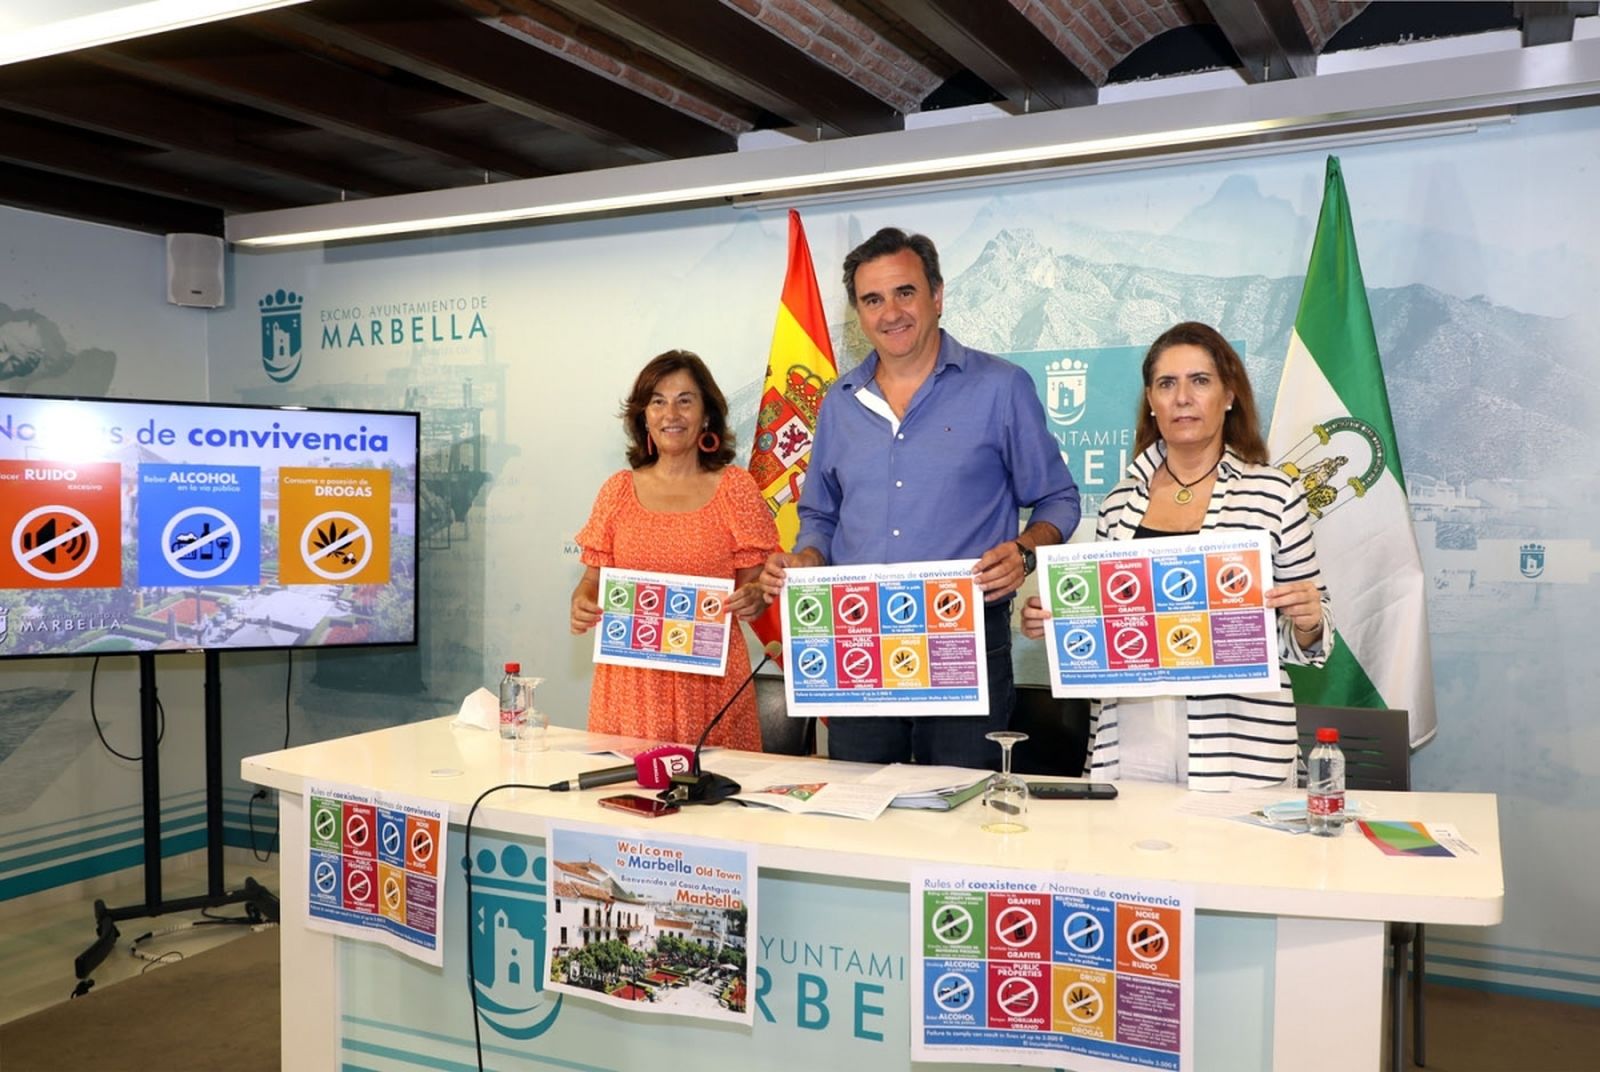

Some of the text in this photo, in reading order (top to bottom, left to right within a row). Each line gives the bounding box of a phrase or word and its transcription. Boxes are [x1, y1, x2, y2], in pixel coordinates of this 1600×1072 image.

[321, 296, 487, 322] EXCMO. AYUNTAMIENTO DE
[321, 312, 488, 349] MARBELLA
[137, 419, 388, 452] de convivencia
[1053, 428, 1136, 446] NTAMIE
[24, 468, 77, 481] RUIDO
[144, 472, 239, 485] Beber ALCOHOL
[315, 486, 372, 497] DROGAS
[1083, 550, 1138, 560] coexistence
[1199, 540, 1259, 552] convivencia
[817, 573, 866, 582] coexistence
[919, 568, 972, 578] convivencia
[20, 619, 121, 632] MARBELLA
[618, 842, 684, 859] Welcome
[617, 856, 742, 881] to Marbella Old Town
[621, 875, 741, 895] Bienvenidos al Casco Antiguo de
[676, 890, 741, 909] Marbella
[924, 879, 951, 889] Rules
[954, 880, 966, 889] of
[968, 880, 1037, 891] coexistence
[1049, 883, 1090, 895] Normas
[1093, 888, 1106, 897] de
[1109, 892, 1180, 907] convivencia
[1136, 911, 1160, 920] NOISE
[760, 935, 903, 980] YUNTAMI
[944, 961, 980, 969] ALCOHOL
[997, 969, 1042, 977] PROPERTIES
[1013, 963, 1040, 971] PUBLIC
[1132, 961, 1158, 970] RUIDO
[939, 1013, 975, 1021] ALCOHOL
